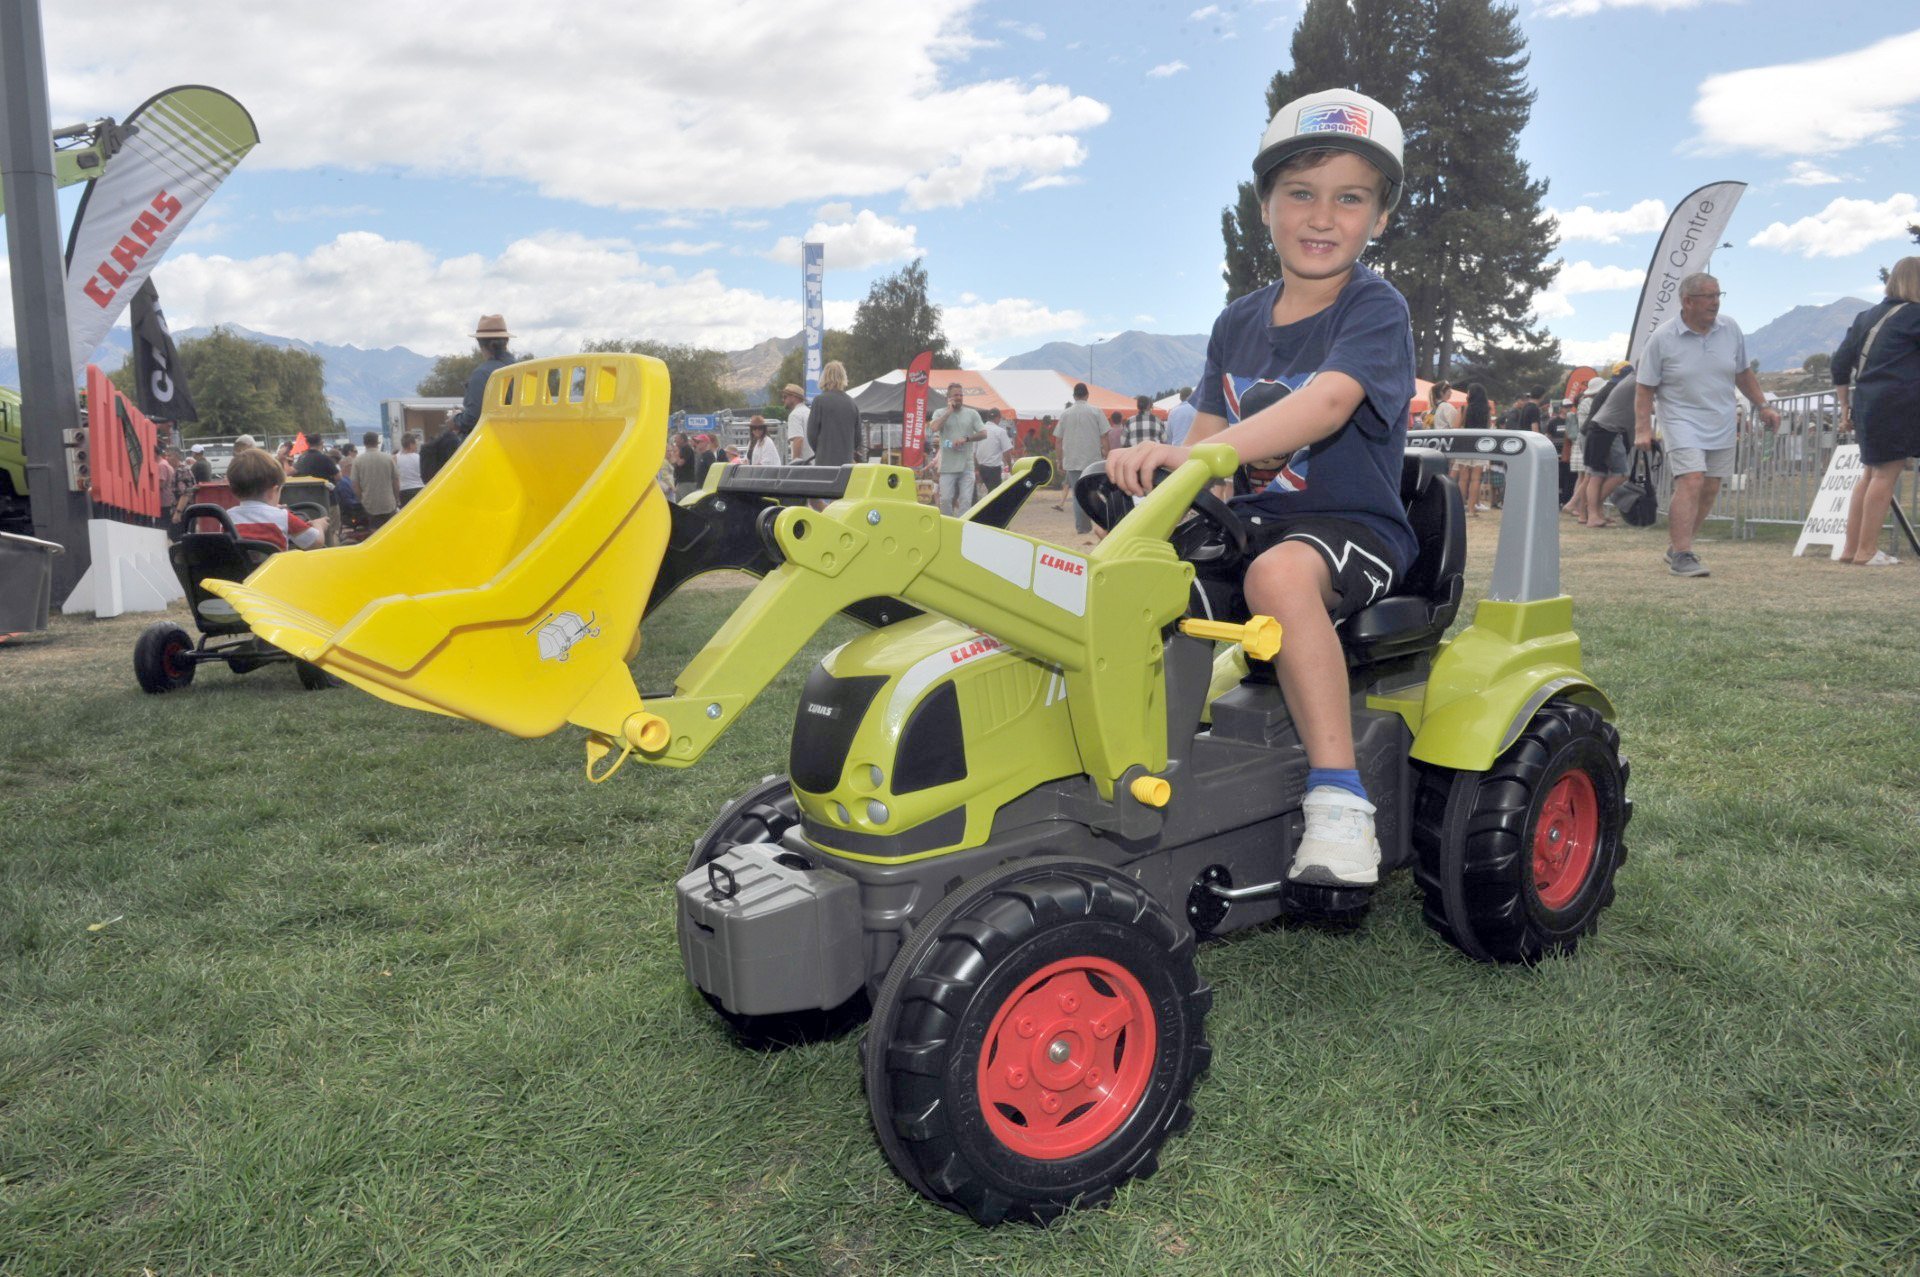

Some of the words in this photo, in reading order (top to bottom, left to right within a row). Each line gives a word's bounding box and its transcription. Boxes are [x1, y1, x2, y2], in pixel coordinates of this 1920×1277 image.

[1669, 200, 1715, 268] Centre
[83, 189, 183, 308] CLAAS
[905, 412, 915, 448] WHEELS
[1404, 437, 1454, 452] RION
[1820, 475, 1861, 491] JUDGI
[1829, 497, 1847, 512] IN
[1040, 553, 1084, 576] CLAAS
[950, 638, 1004, 664] CLAA
